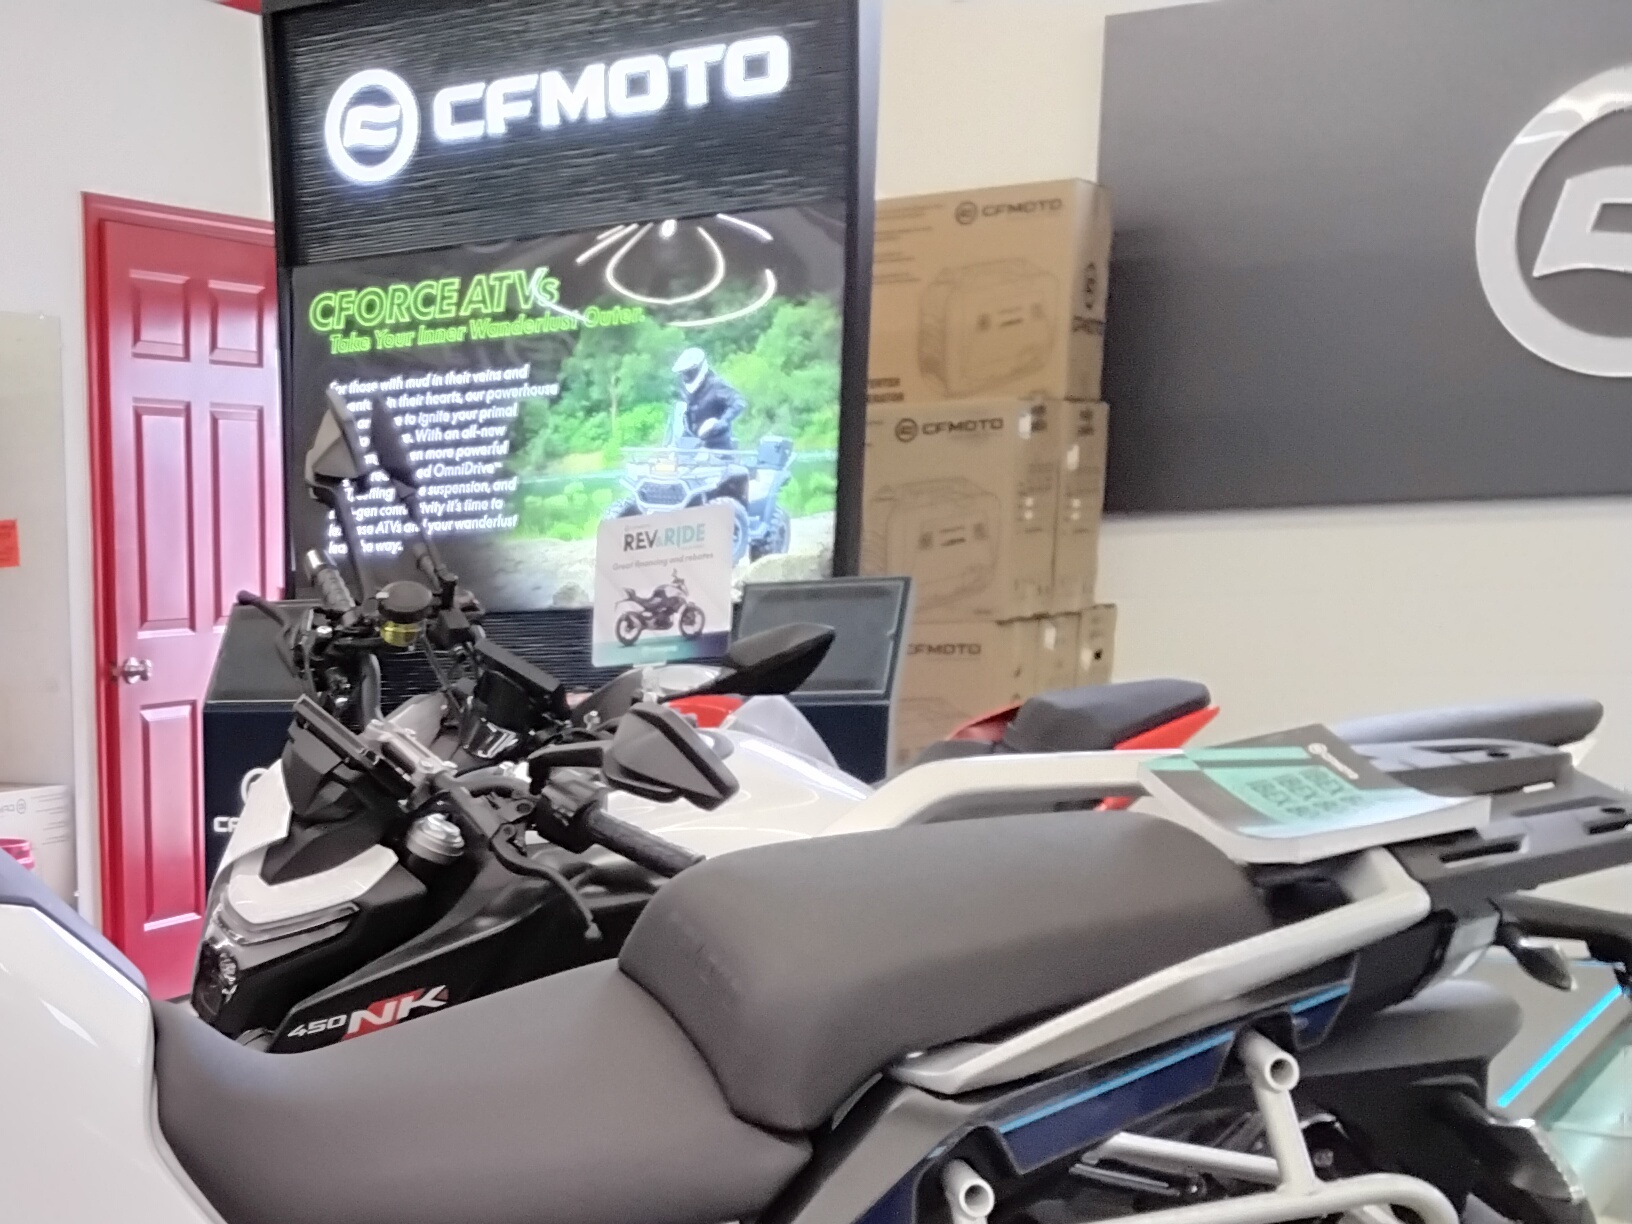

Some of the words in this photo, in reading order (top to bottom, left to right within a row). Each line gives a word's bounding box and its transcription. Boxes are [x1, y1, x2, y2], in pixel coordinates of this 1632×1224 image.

[432, 35, 791, 144] CFMOTO
[981, 198, 1063, 217] CFMOTO
[309, 276, 461, 332] CFORCE
[459, 267, 561, 316] ATVs
[330, 333, 372, 354] Take
[374, 328, 415, 350] Your
[418, 323, 467, 346] Inner
[469, 313, 577, 340] Wanderlust
[584, 305, 647, 327] Outer.
[349, 378, 379, 394] those
[380, 374, 403, 391] with
[405, 372, 431, 389] mud
[431, 373, 443, 386] in
[445, 370, 471, 385] their
[473, 369, 501, 383] veins
[503, 363, 530, 380] and
[398, 393, 424, 407] their
[465, 391, 485, 402] our
[486, 383, 559, 404] powerhouse
[404, 413, 416, 425] to
[418, 410, 450, 427] ignite
[451, 409, 478, 425] your
[479, 402, 517, 423] primal
[922, 417, 1004, 435] CFMOTO
[415, 427, 442, 442] With
[444, 430, 460, 440] an
[461, 424, 507, 439] all-new
[425, 449, 454, 460] more
[455, 440, 510, 461] powerful
[427, 481, 491, 498] suspension,
[492, 476, 519, 491] and
[464, 499, 489, 512] time
[491, 498, 504, 510] to
[375, 519, 402, 535] ATVs
[428, 520, 453, 536] your
[455, 514, 519, 531] wanderlust
[623, 529, 659, 552] REV
[664, 523, 706, 549] RIDE
[287, 1014, 347, 1038] 450
[346, 984, 447, 1035] NK
